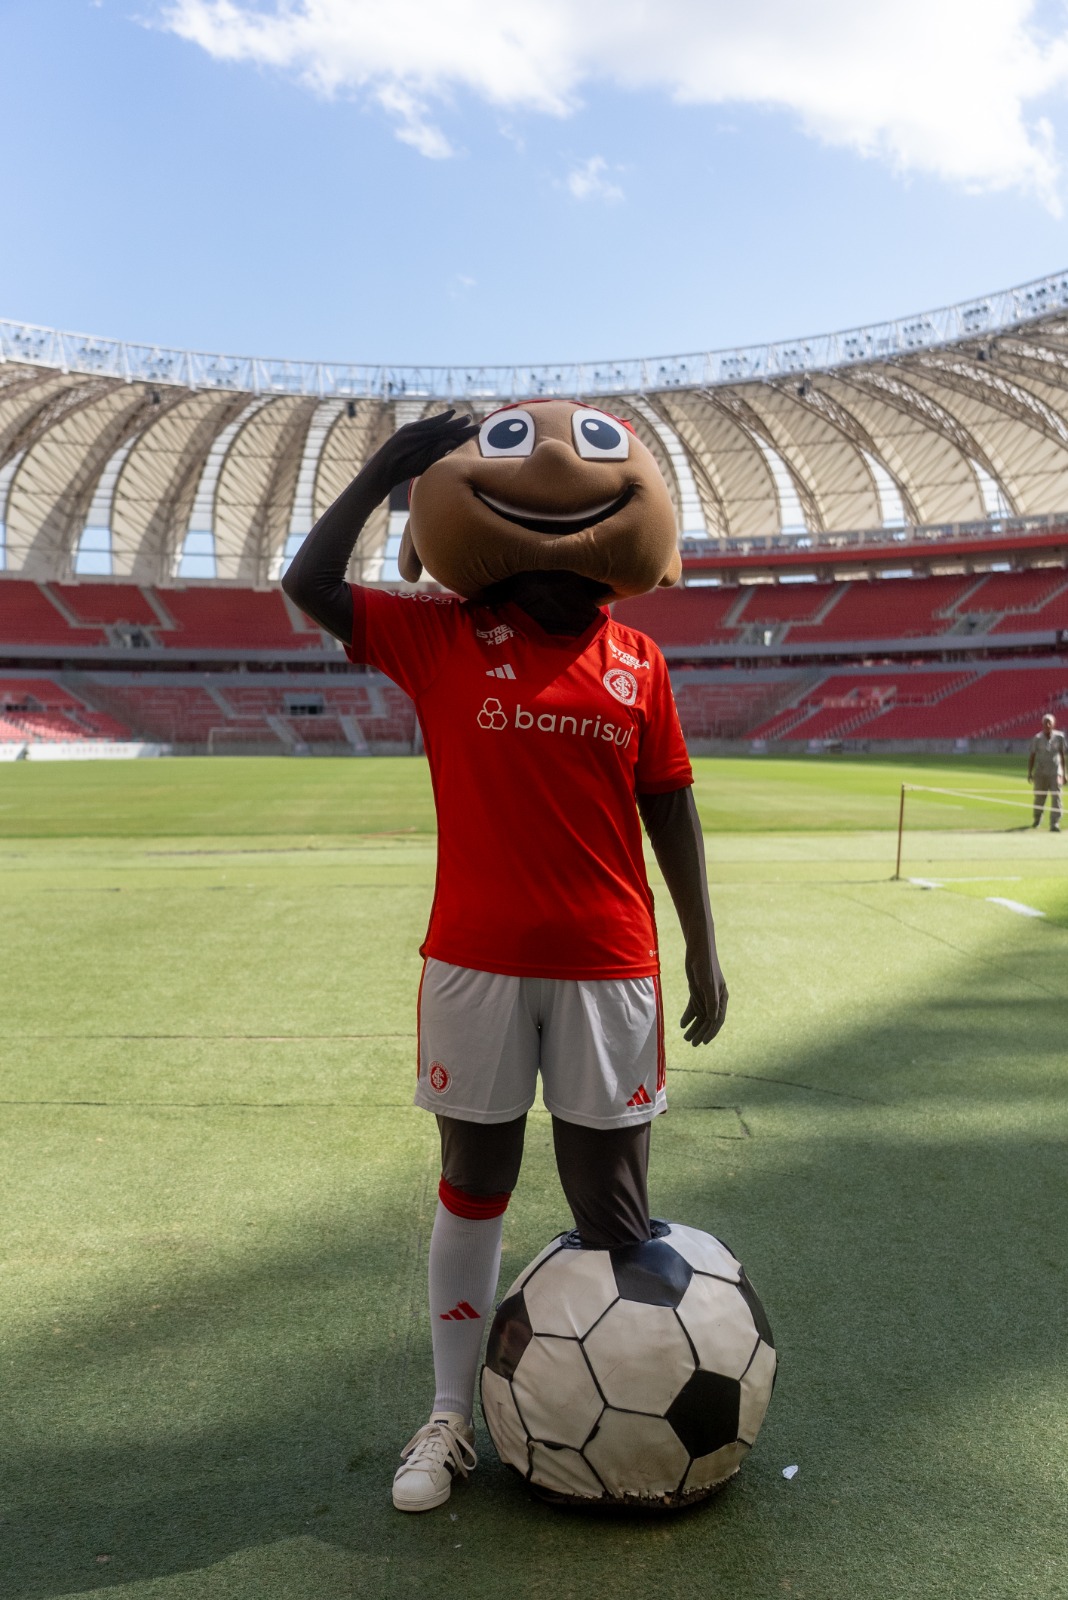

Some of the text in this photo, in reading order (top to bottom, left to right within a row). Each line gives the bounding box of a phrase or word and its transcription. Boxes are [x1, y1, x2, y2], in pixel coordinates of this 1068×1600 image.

[495, 630, 514, 645] BET
[619, 657, 640, 670] BET
[515, 704, 634, 749] banrisul
